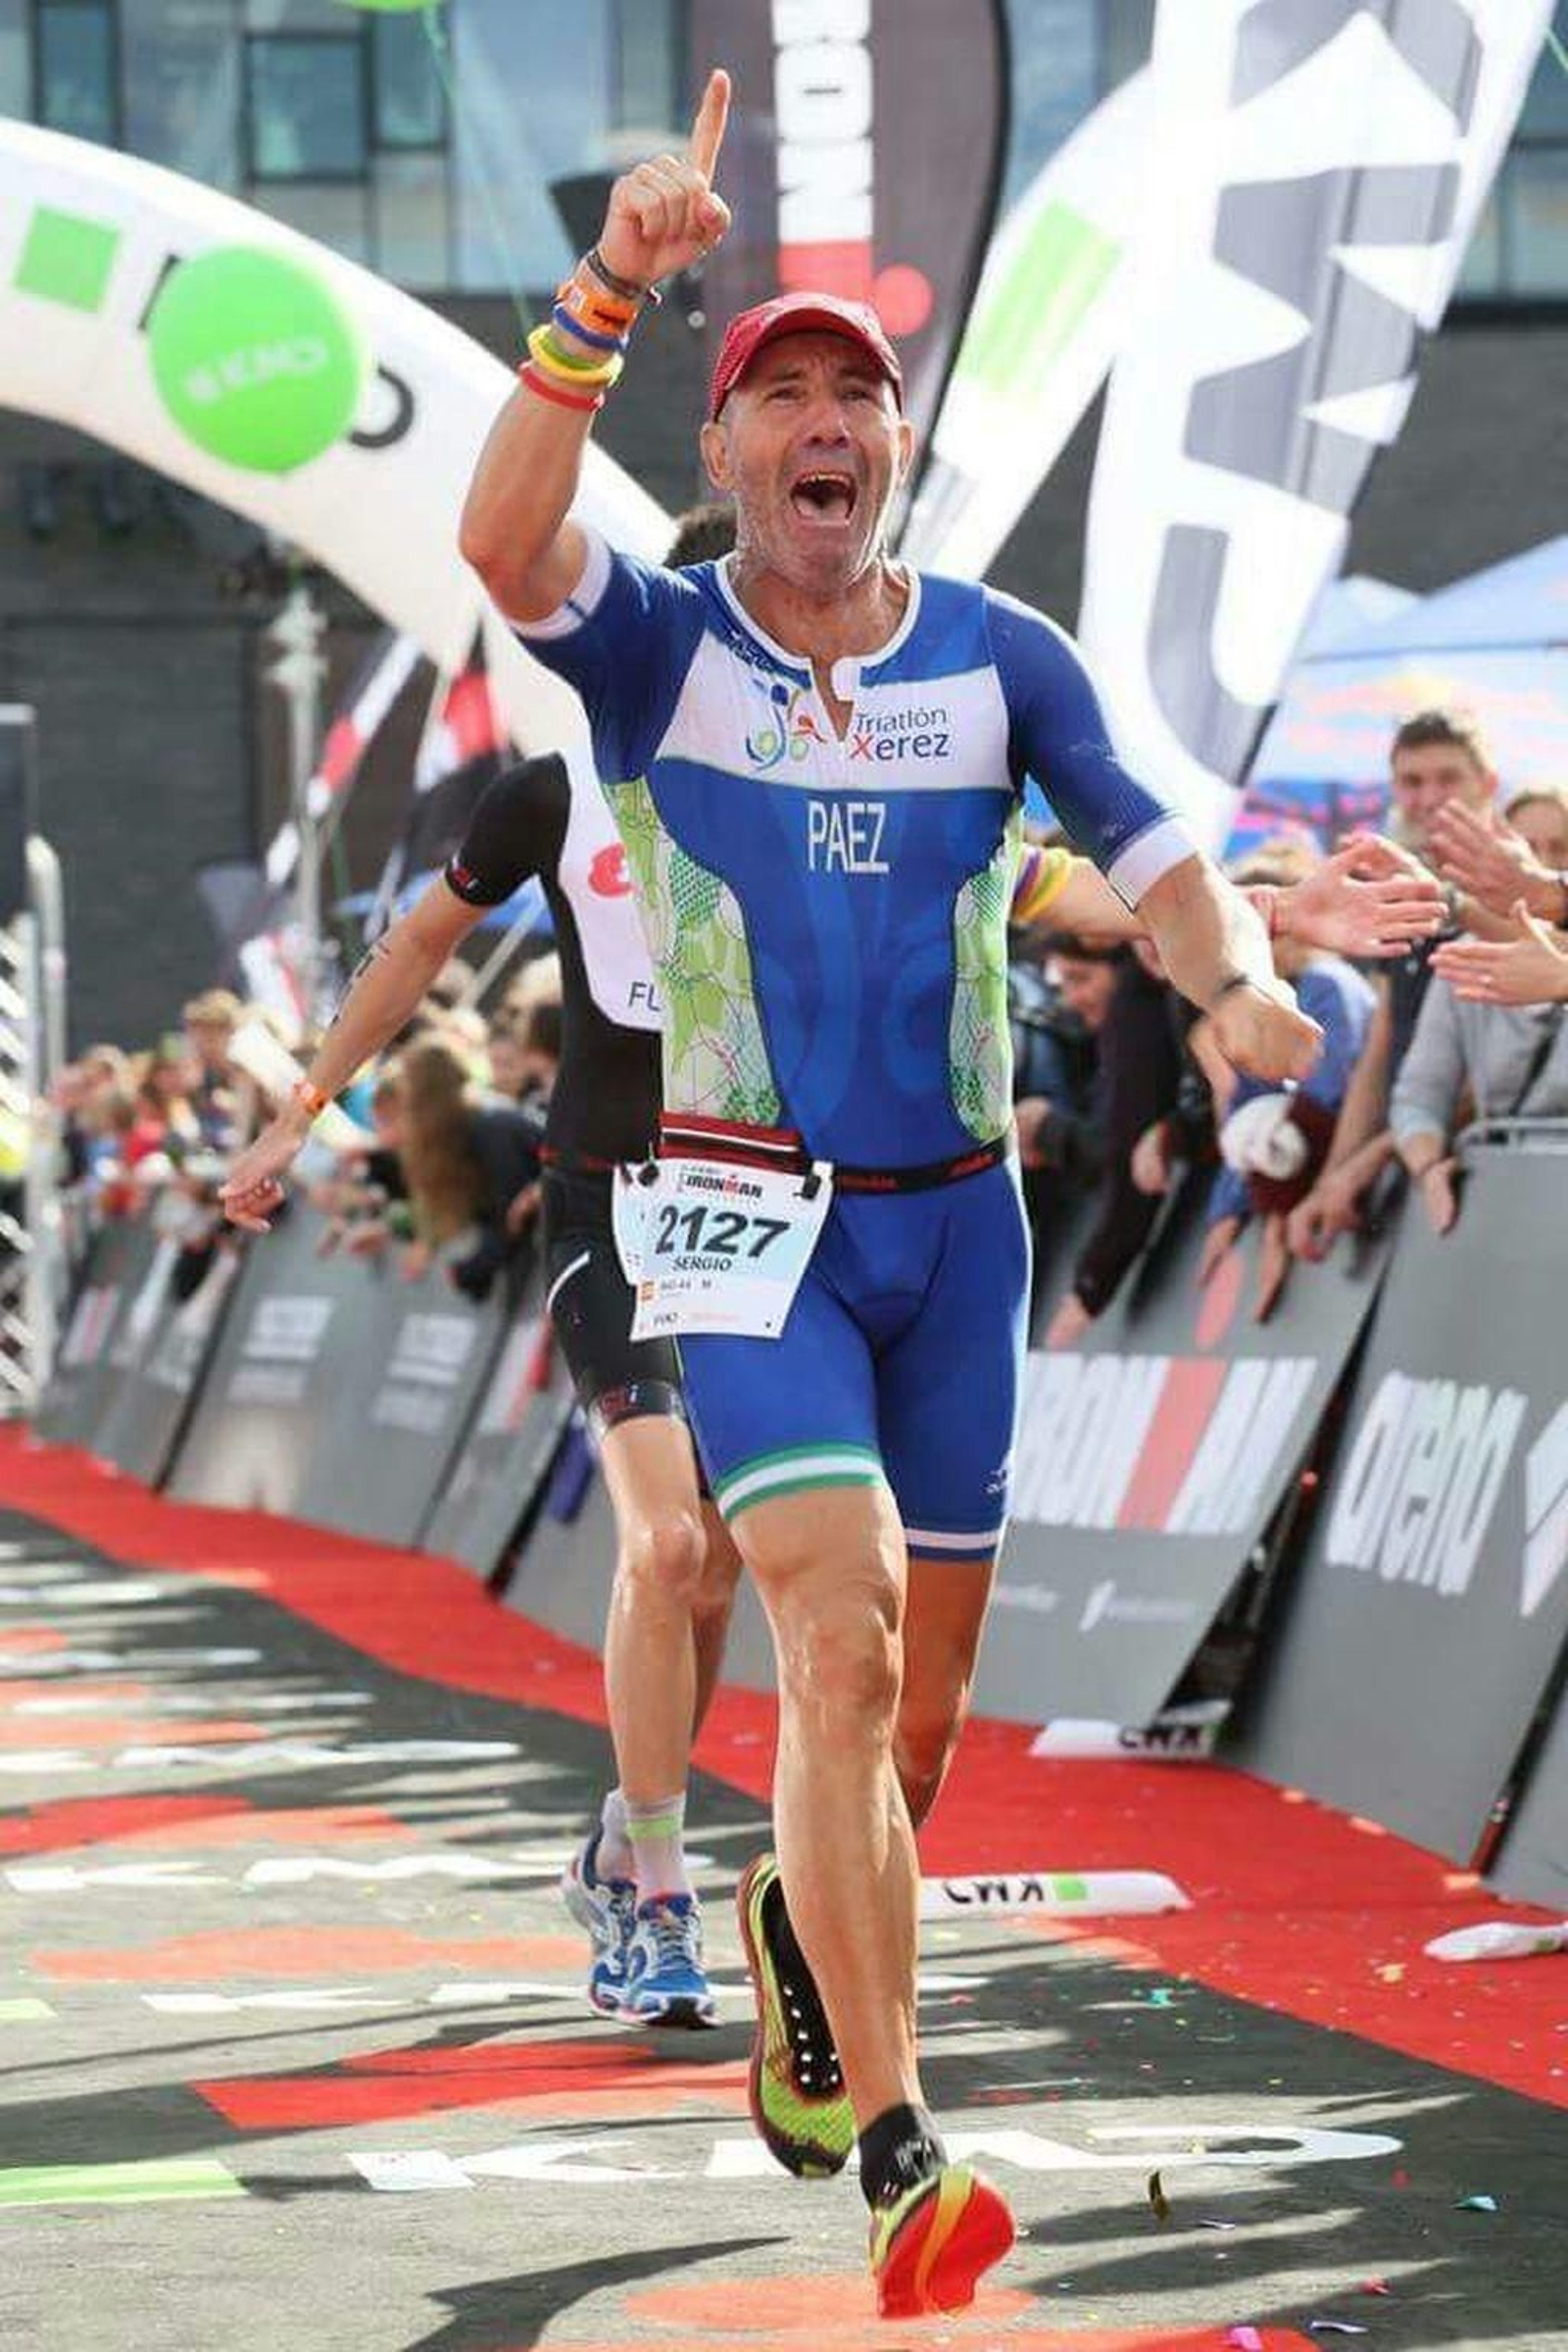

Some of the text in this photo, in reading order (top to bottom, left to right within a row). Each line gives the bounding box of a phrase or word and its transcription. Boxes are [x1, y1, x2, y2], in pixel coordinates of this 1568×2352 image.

[850, 733, 950, 761] Xerez
[808, 801, 890, 873] PAEZ
[686, 1173, 762, 1198] IRONMAN
[655, 1204, 791, 1257] 2127
[673, 1256, 732, 1272] SERGIO
